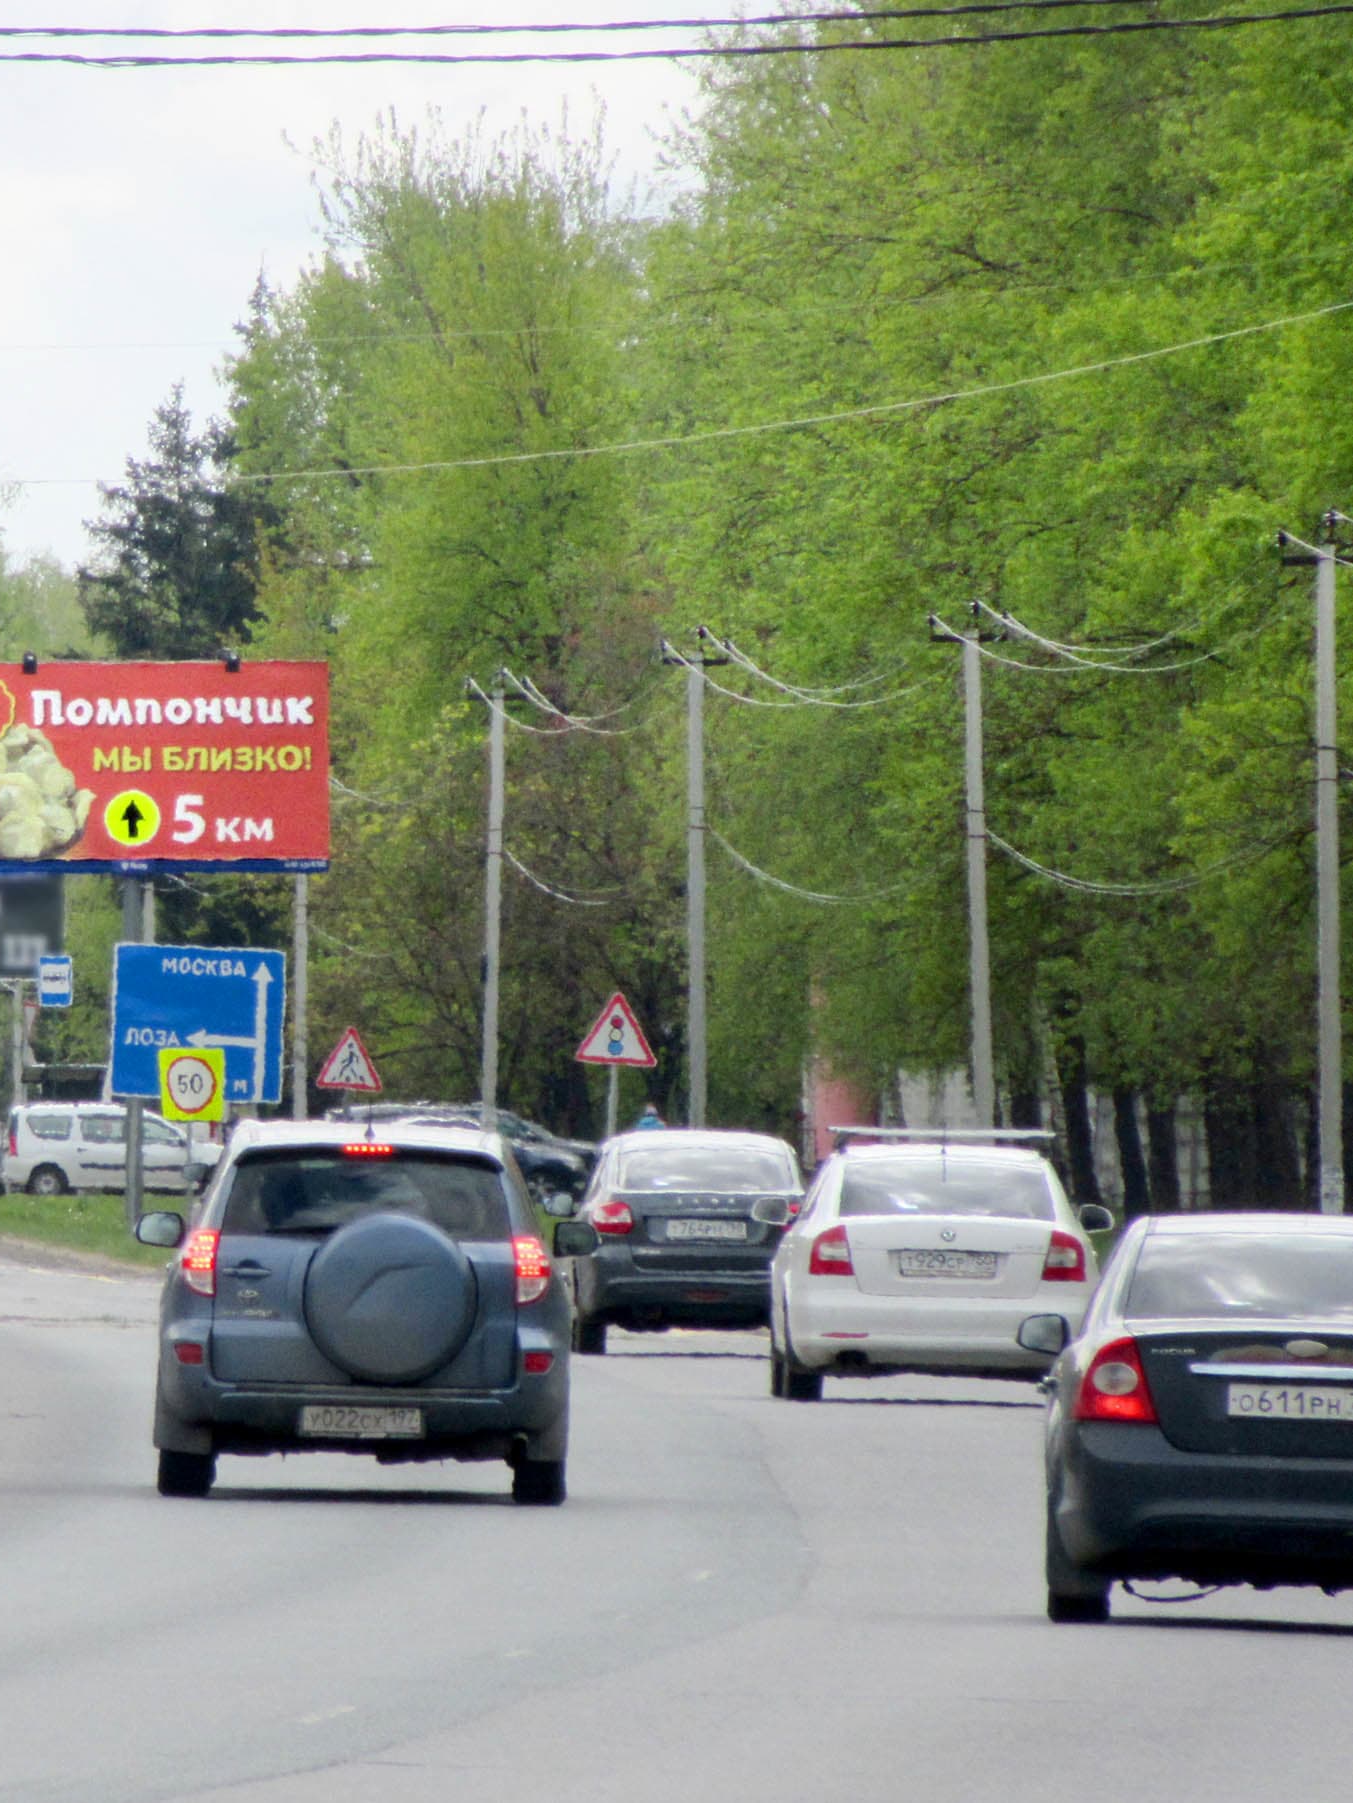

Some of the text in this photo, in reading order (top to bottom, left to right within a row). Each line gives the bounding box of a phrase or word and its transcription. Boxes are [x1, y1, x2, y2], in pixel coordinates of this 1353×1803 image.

[30, 689, 315, 727] Помпончик
[92, 745, 313, 773] МЫ БЛИЗКО!
[171, 793, 275, 845] 5 км
[161, 957, 247, 978] МОСКВА
[123, 1027, 182, 1047] ЛОЗА
[176, 1072, 204, 1095] 50
